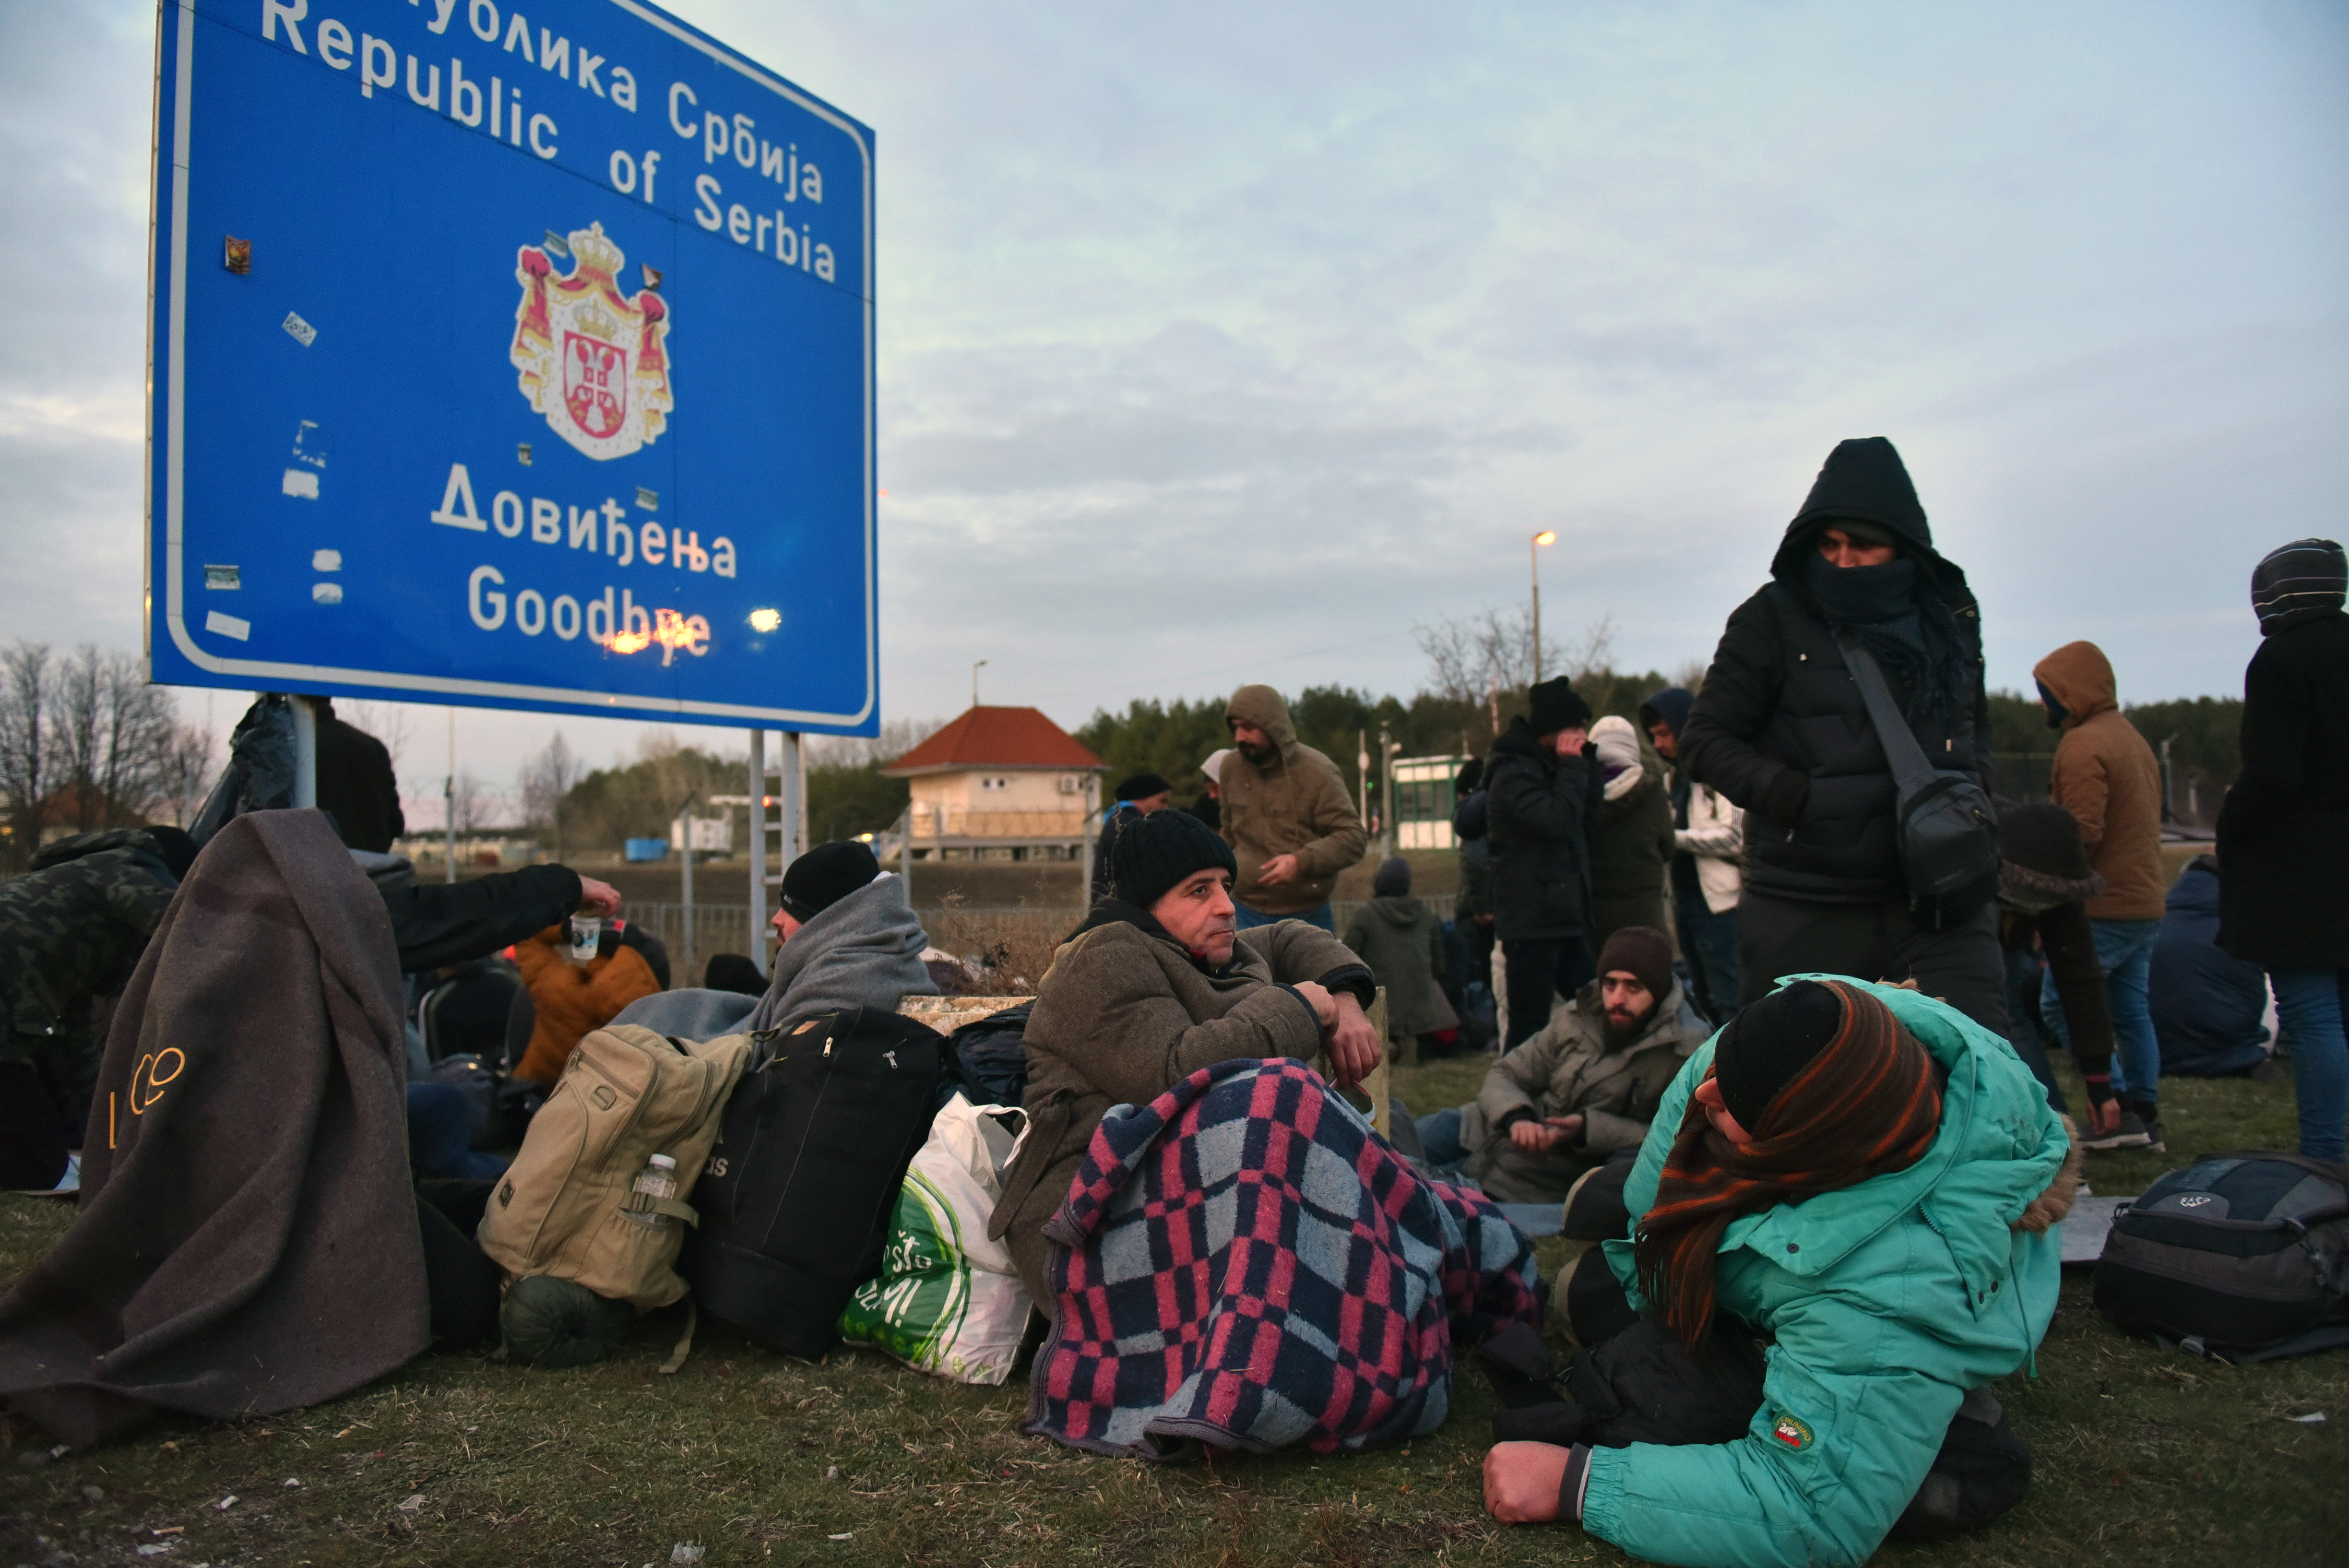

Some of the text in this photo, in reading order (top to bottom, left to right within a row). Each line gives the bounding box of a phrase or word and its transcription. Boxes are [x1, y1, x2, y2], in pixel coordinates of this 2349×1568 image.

[262, 0, 835, 282] Republic of Serbia
[409, 0, 822, 203] ублика Србија
[431, 463, 736, 578] Довиђења
[469, 565, 711, 668] Goodbye
